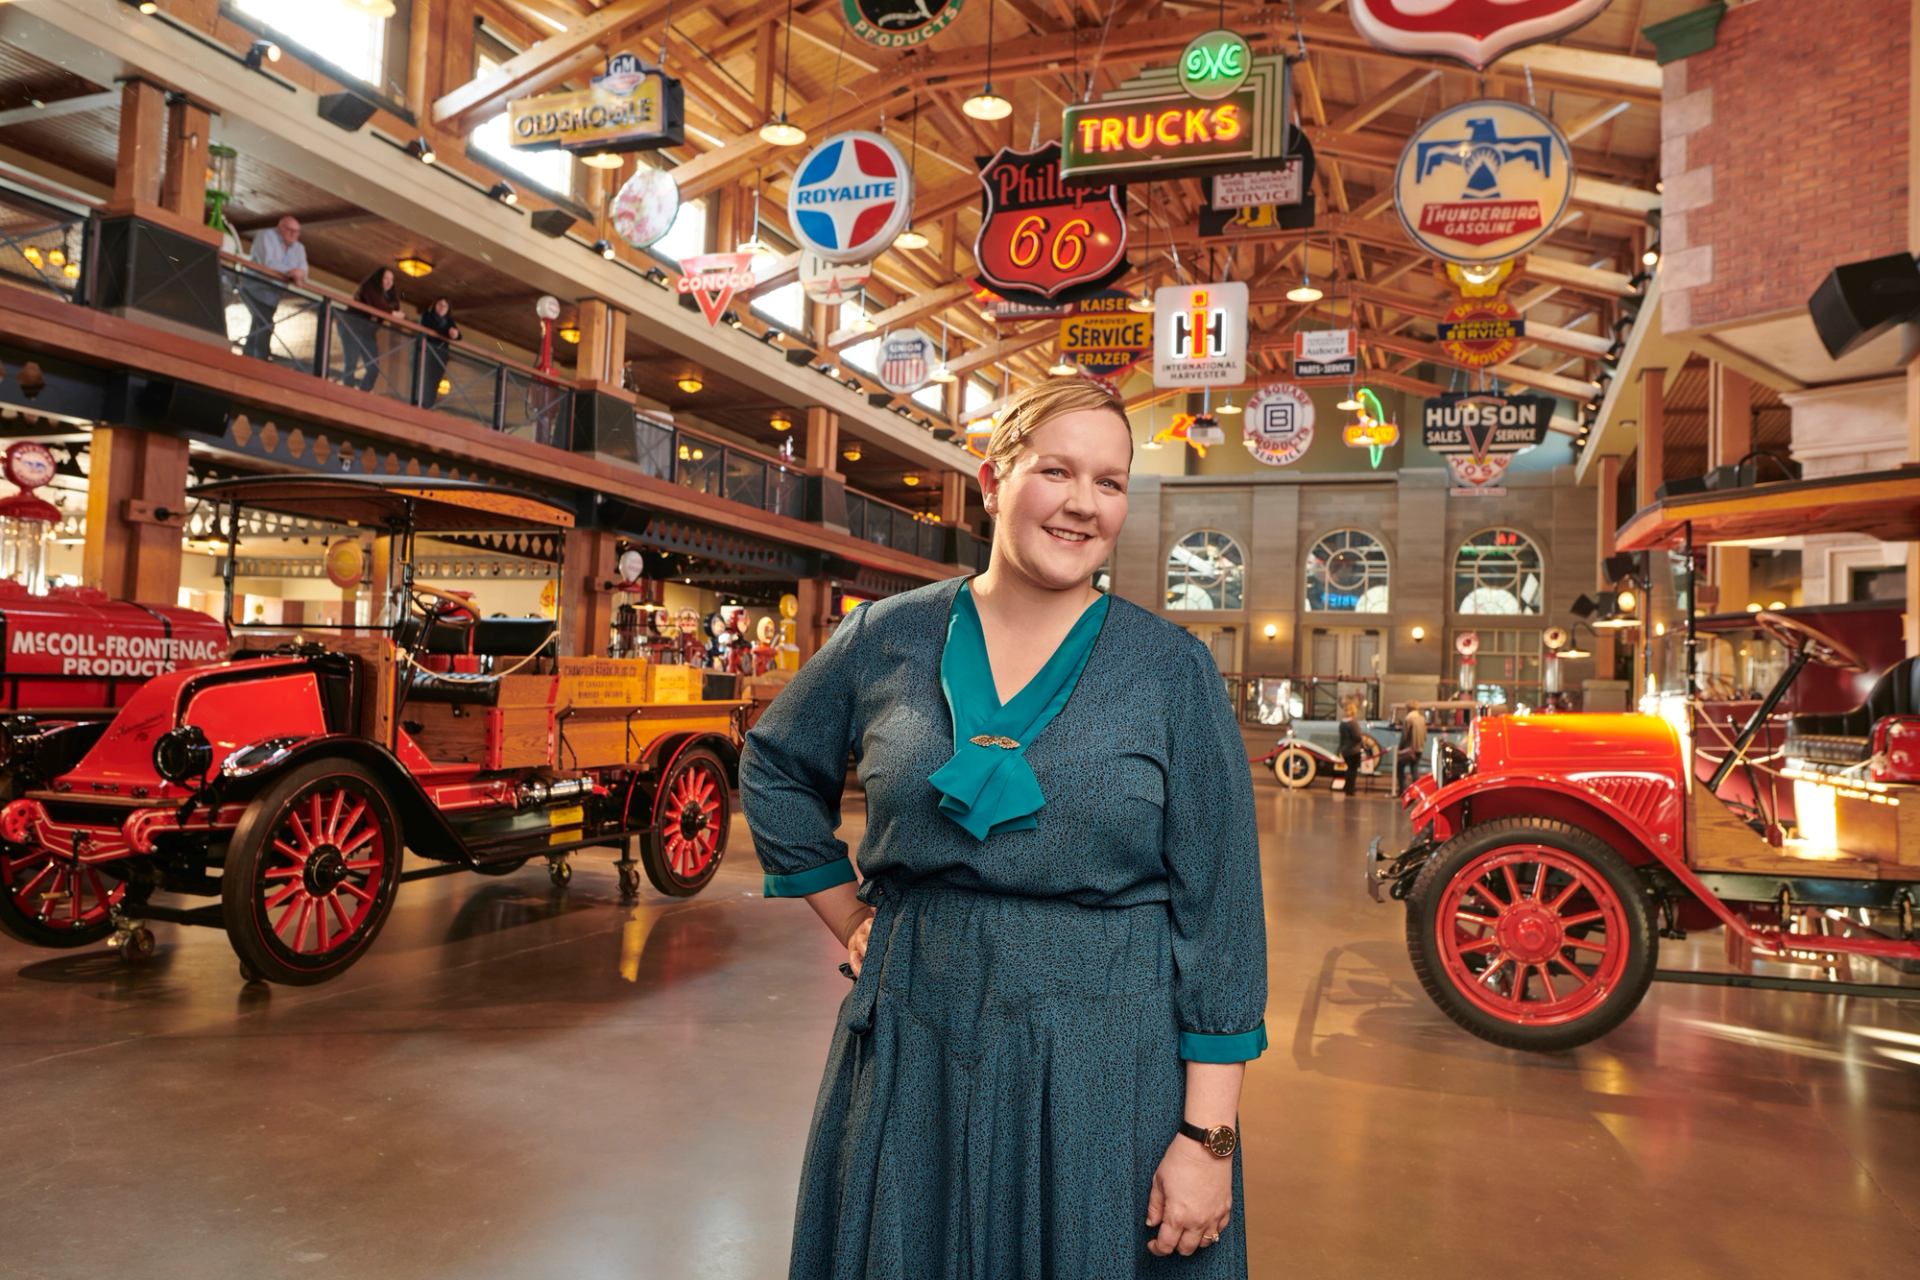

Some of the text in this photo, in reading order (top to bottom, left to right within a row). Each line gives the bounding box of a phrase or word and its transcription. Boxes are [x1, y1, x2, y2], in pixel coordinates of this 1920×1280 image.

[854, 7, 958, 47] PRODUCTS
[609, 56, 636, 75] GM
[1186, 43, 1243, 80] GMC
[1079, 104, 1241, 154] TRUCKS
[797, 182, 896, 206] ROYALITE
[1220, 189, 1294, 204] SERVICE
[1426, 206, 1539, 226] THUNDERBIRD
[1444, 222, 1515, 235] GASOLINE
[1009, 215, 1094, 272] 66
[678, 272, 753, 292] CONOCO
[1067, 323, 1144, 347] SERVICE
[1446, 327, 1516, 340] SERVICE
[1076, 352, 1131, 366] FRAZER
[1162, 361, 1237, 371] INTERNATIONAL
[1170, 370, 1227, 380] HARVESTER
[1426, 404, 1537, 428] HUDSON
[1427, 428, 1537, 443] SALES SERVICE
[63, 657, 176, 676] PRODUCTS
